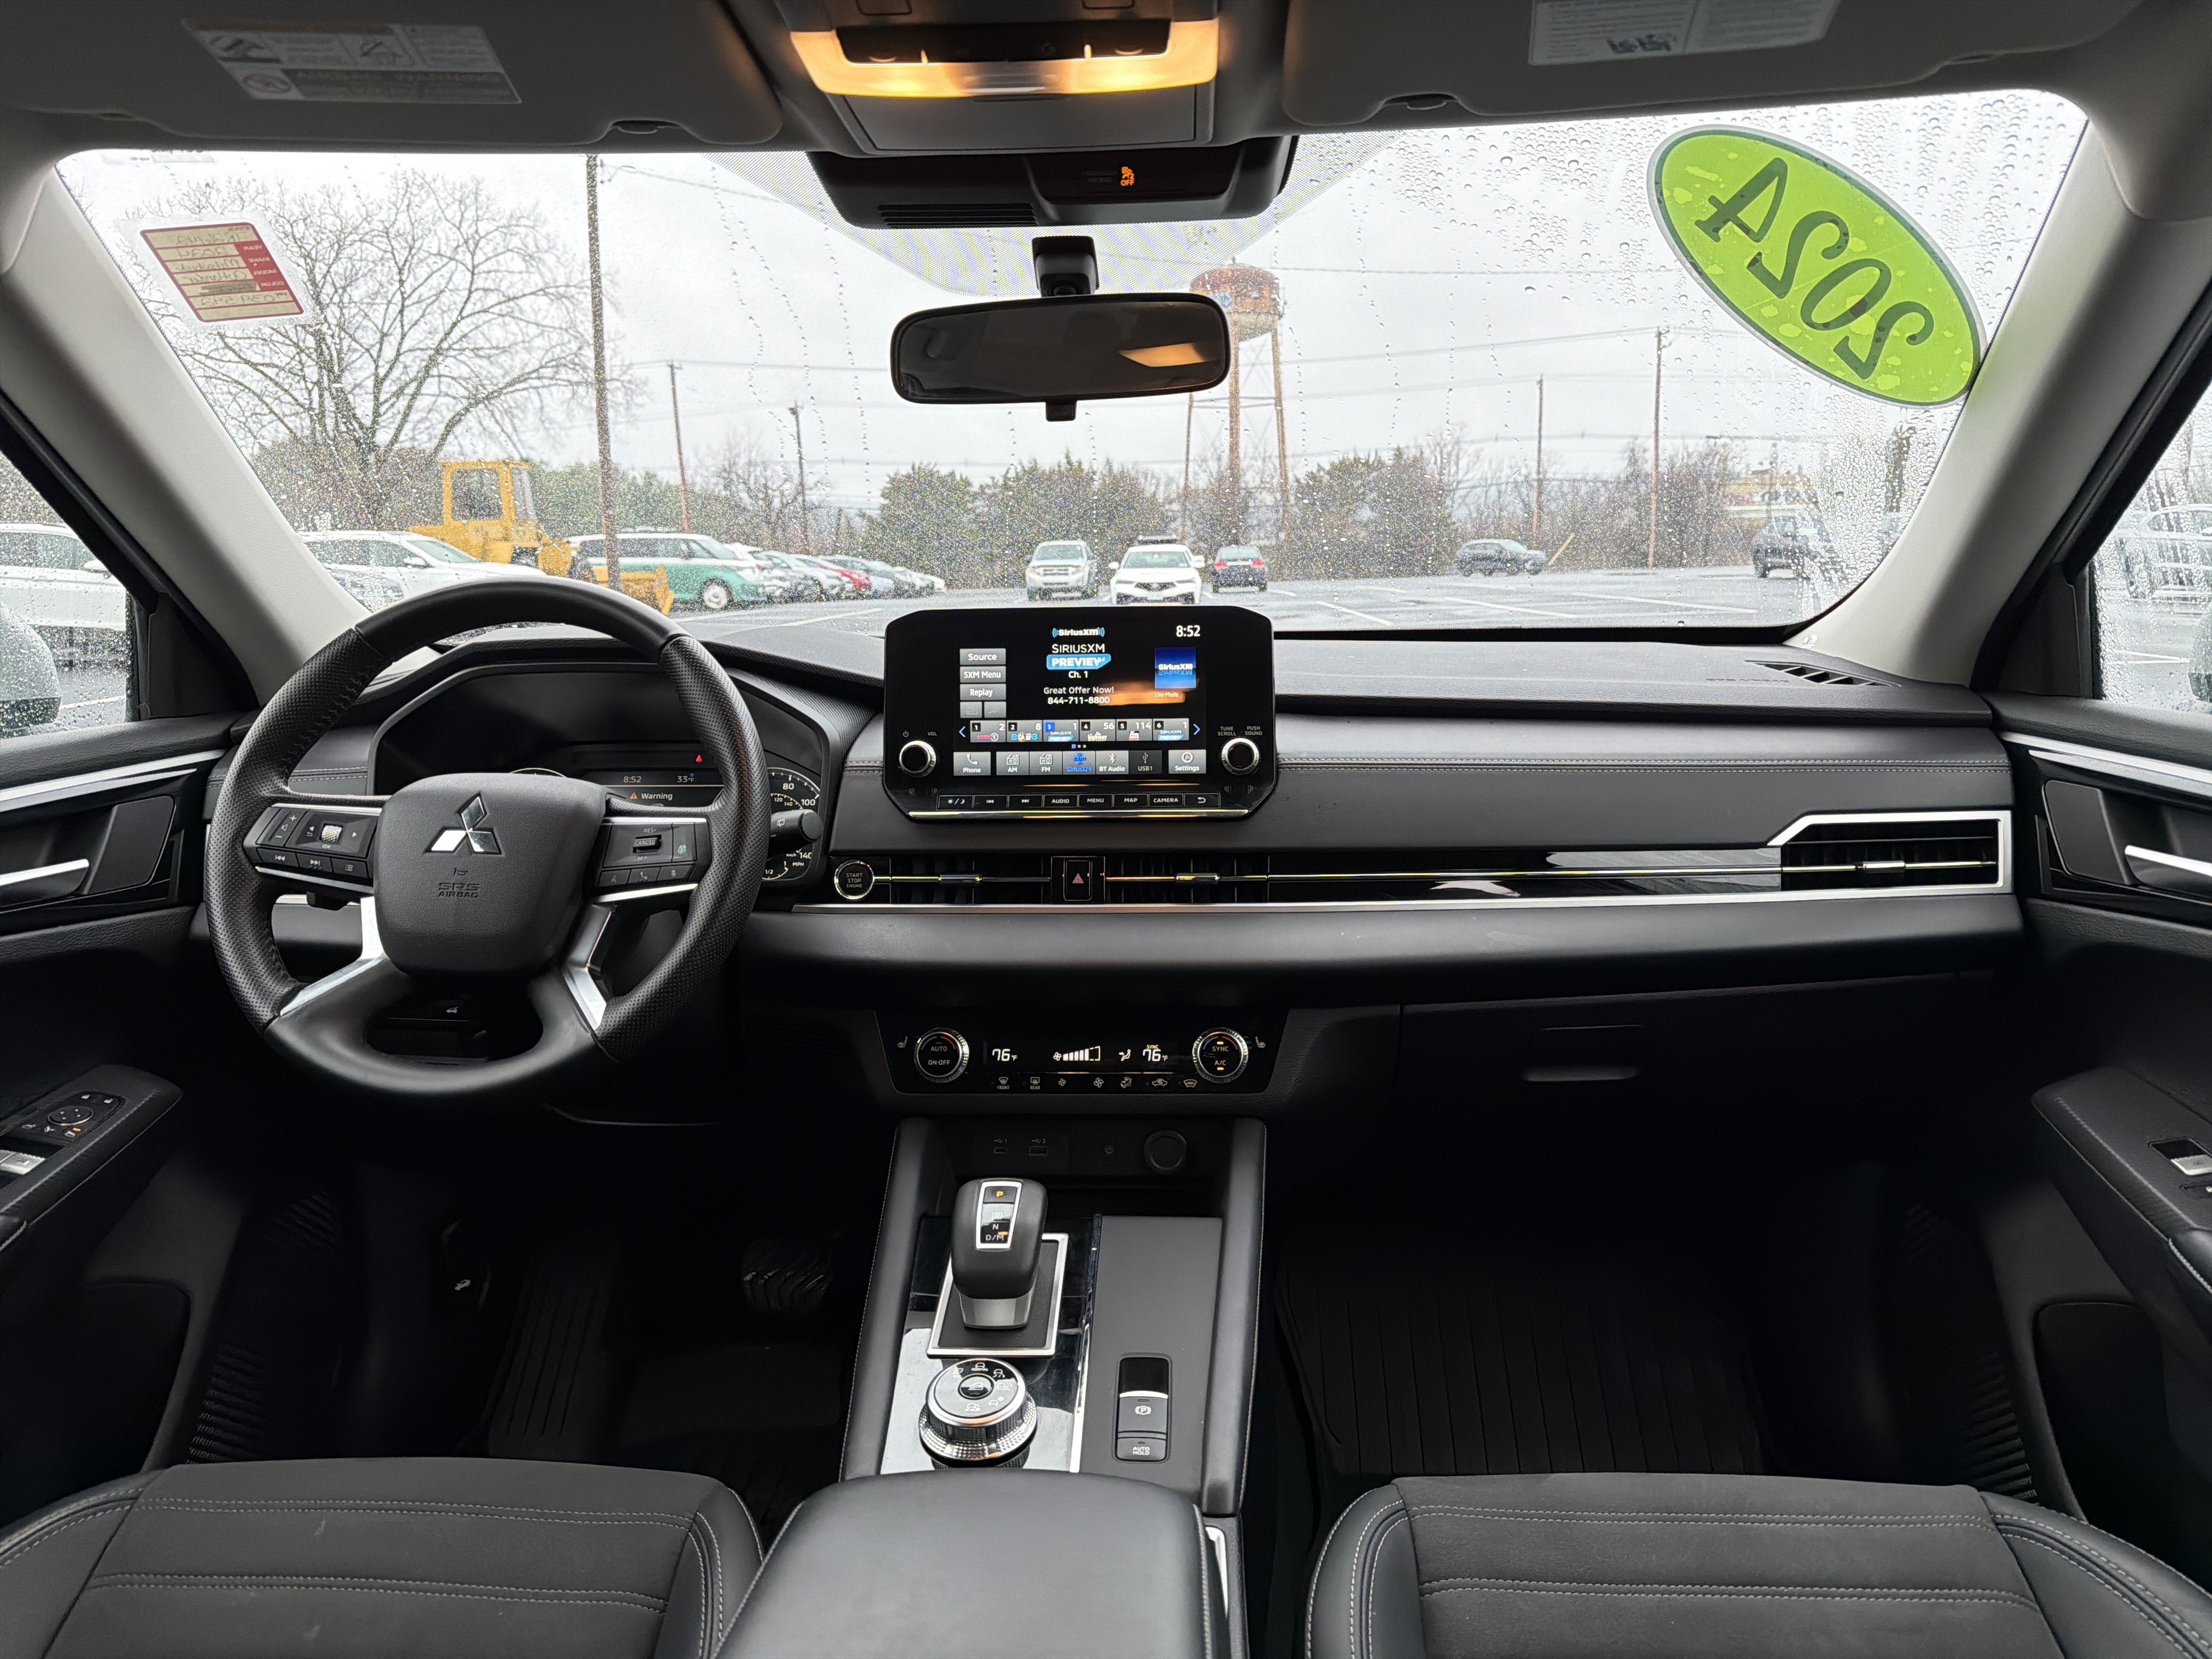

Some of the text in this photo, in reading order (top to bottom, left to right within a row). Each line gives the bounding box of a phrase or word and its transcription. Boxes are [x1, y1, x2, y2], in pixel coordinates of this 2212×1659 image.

[1176, 625, 1201, 637] 8:52
[1051, 644, 1105, 653] SIRIUSXM
[1051, 657, 1106, 667] PREVIEW
[963, 671, 1001, 679] SXM Menu
[969, 689, 994, 697] Replay
[1047, 696, 1110, 705] 844-711-8800
[641, 792, 673, 801] Warning
[438, 882, 480, 890] SRS
